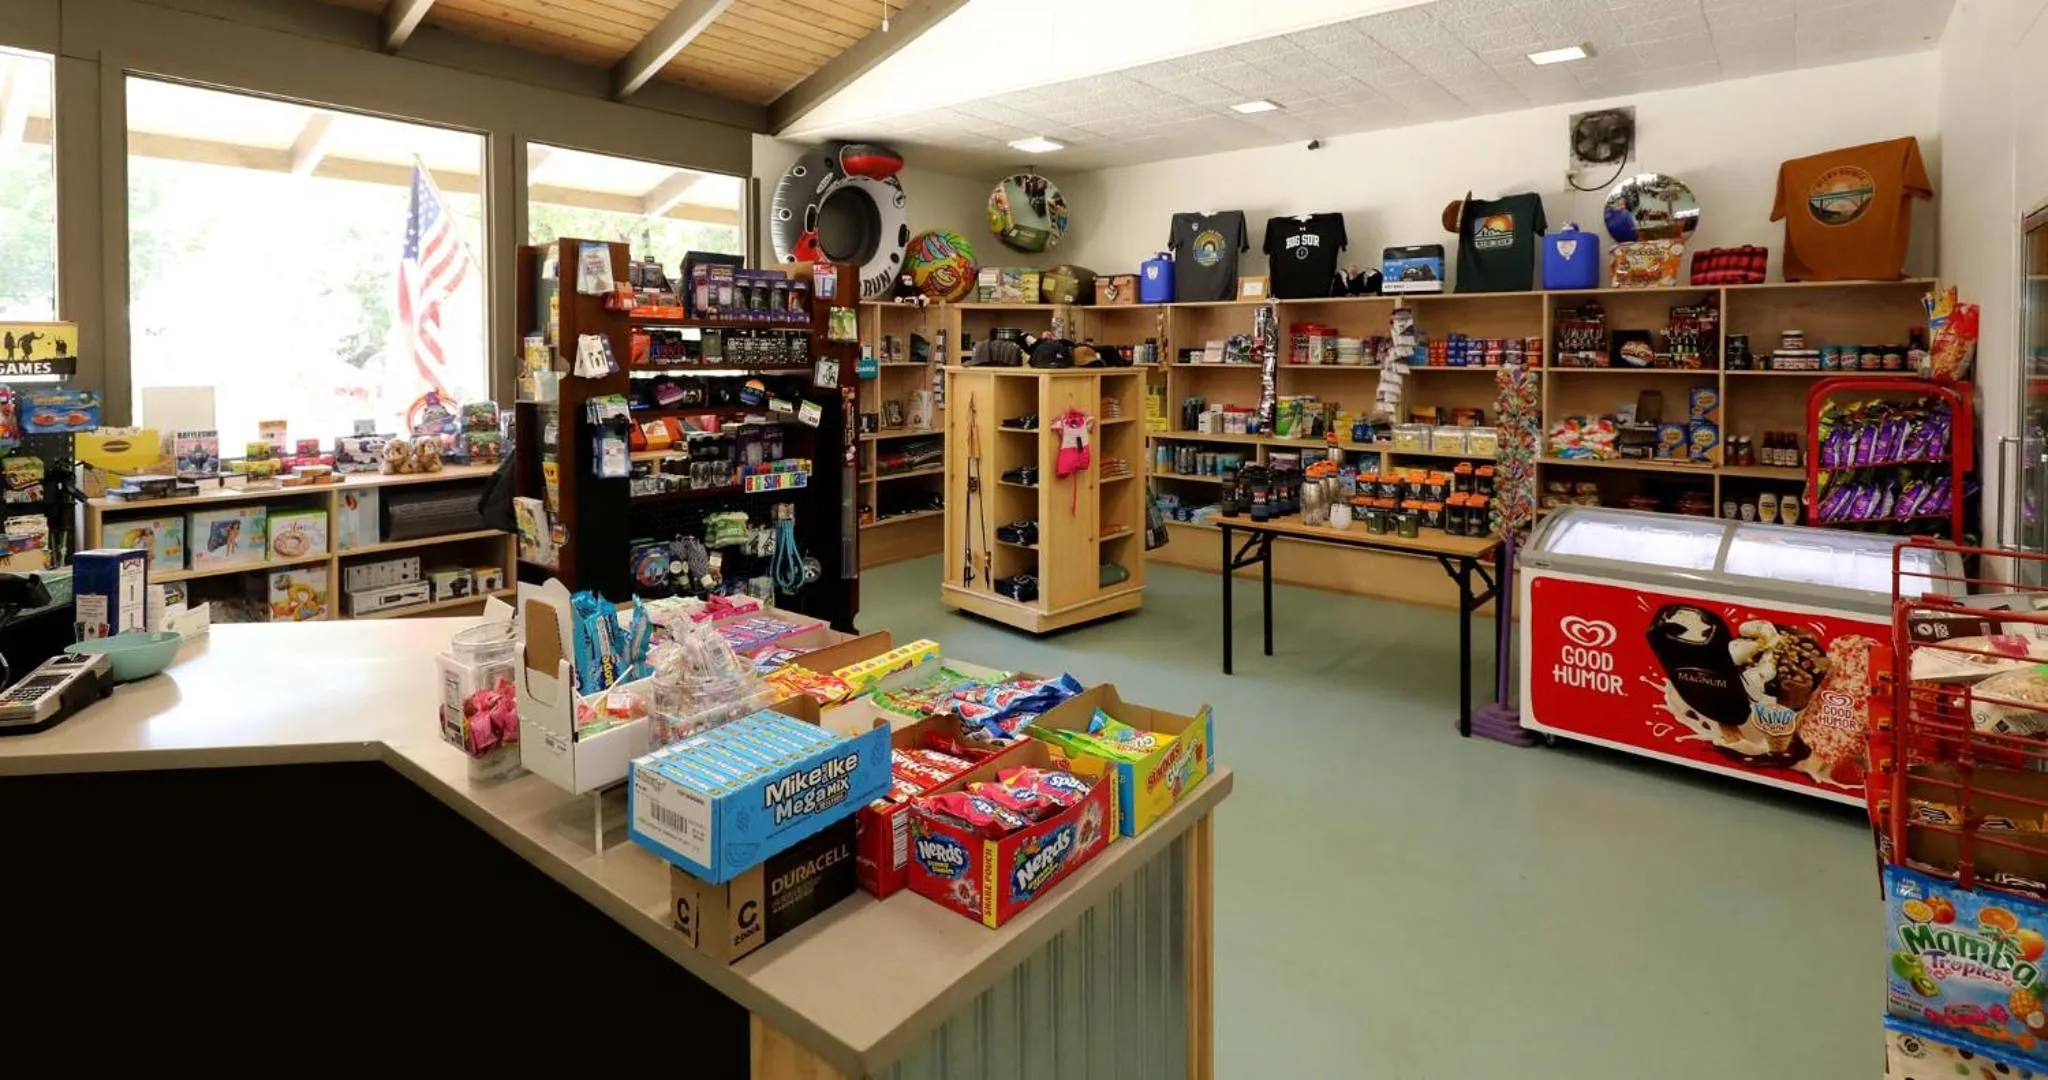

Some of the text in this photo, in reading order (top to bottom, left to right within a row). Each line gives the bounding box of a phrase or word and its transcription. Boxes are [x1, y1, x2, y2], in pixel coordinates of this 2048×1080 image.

[1285, 234, 1320, 250] BIG SUR
[863, 269, 891, 297] RUN
[0, 362, 52, 375] GAMES
[1561, 645, 1614, 672] GOOD
[1552, 664, 1624, 696] HUMOR
[1677, 672, 1728, 688] MAGNUM
[1818, 715, 1856, 729] HUMOR
[1823, 705, 1852, 719] GOOD
[765, 768, 821, 808] Mike
[827, 754, 859, 780] Ike
[771, 843, 850, 897] DURACELL
[676, 897, 690, 926] C
[737, 899, 758, 930] C
[1898, 923, 2039, 988] Mamba
[1922, 950, 2005, 982] Tropics
